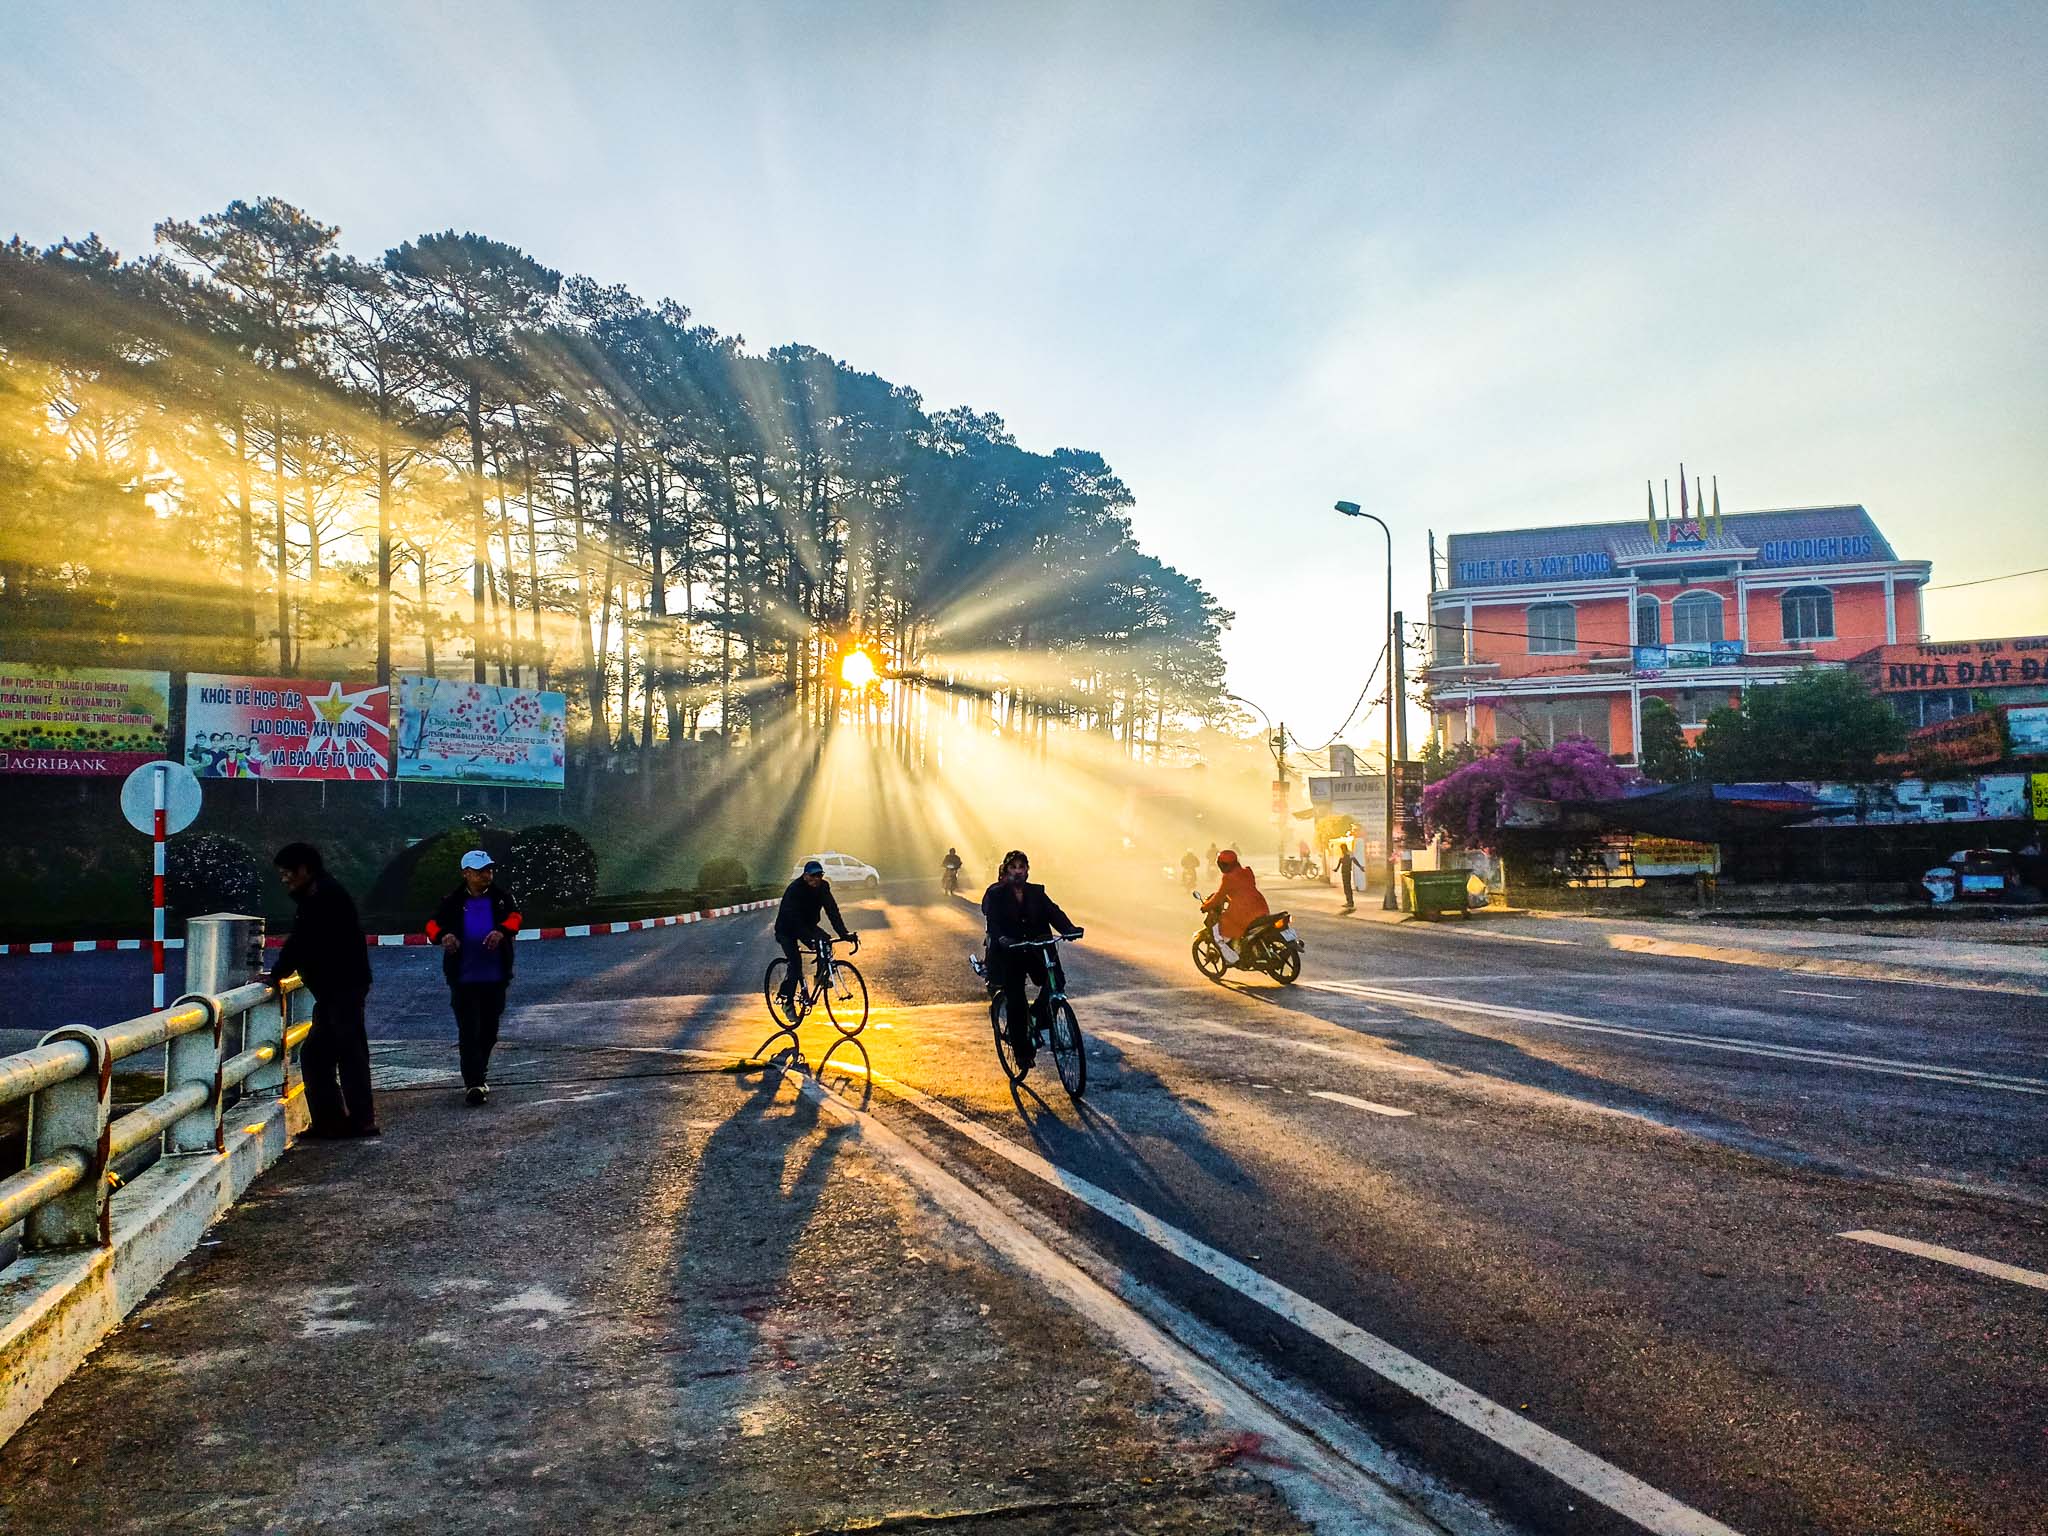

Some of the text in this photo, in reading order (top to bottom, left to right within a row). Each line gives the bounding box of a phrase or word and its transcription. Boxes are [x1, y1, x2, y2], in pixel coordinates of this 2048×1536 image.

[1764, 540, 1799, 561] GIAO
[1524, 559, 1534, 576] &
[1889, 657, 1948, 688] NHÀ
[201, 684, 232, 704] KHỎE
[254, 692, 277, 710] HỌC
[251, 719, 272, 734] LAO
[313, 719, 334, 737] XÂY
[11, 757, 107, 770] AGRIBANK
[289, 746, 312, 766] BẢO
[315, 750, 329, 769] VỆ
[348, 748, 376, 767] QUỐC
